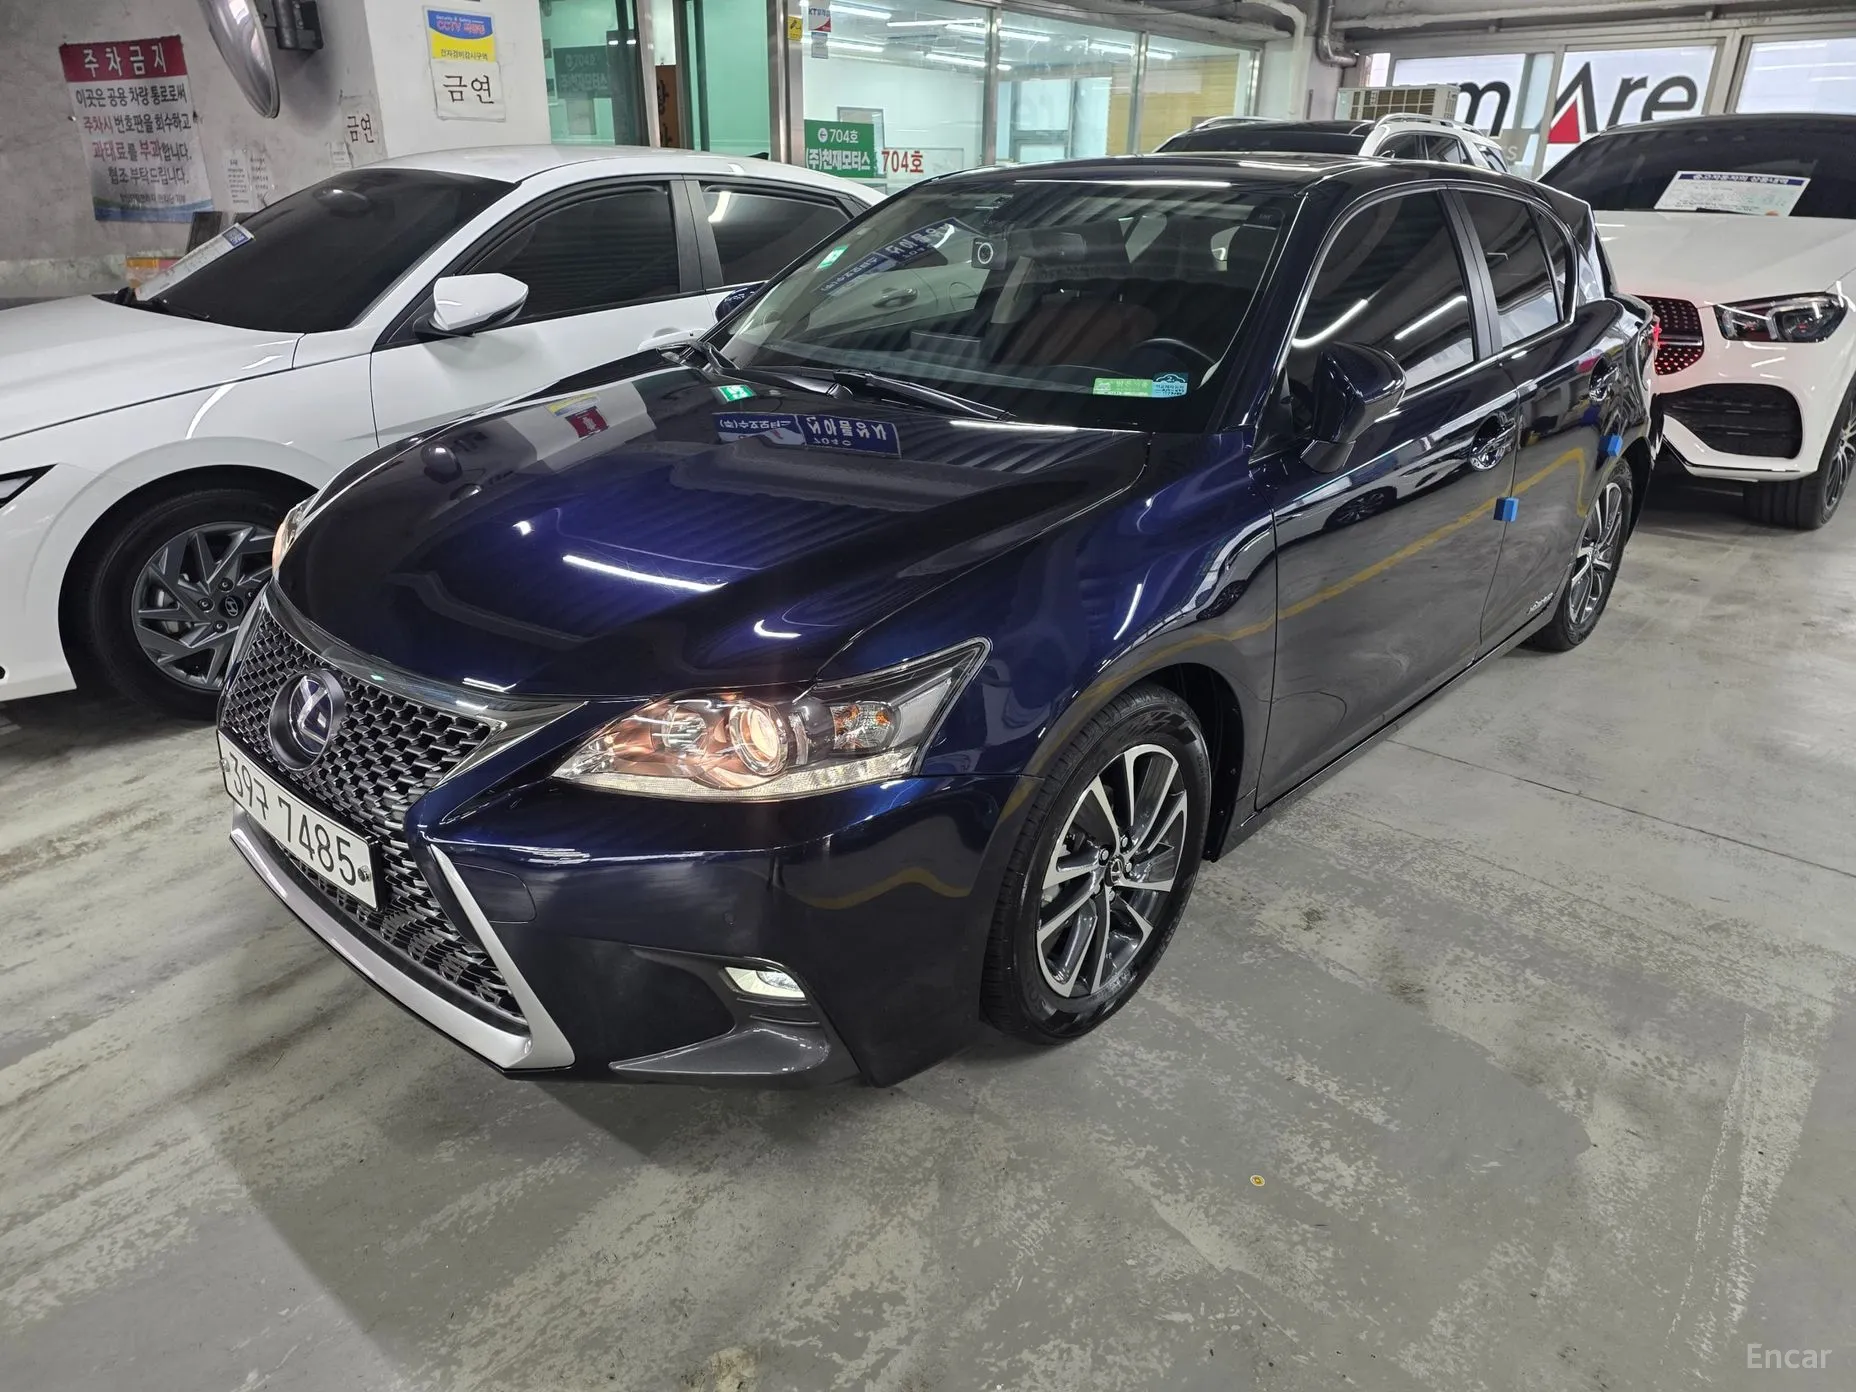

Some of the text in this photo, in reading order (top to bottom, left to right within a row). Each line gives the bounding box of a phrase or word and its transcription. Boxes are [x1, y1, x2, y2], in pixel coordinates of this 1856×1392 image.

[83, 43, 167, 78] 주차금지
[75, 83, 188, 108] 이곳은 공용 차량 통로로써
[443, 74, 494, 104] 금연
[83, 112, 192, 135] 주차시 번호판을 회수하고
[346, 113, 375, 144] 금연
[829, 128, 859, 143] 704호
[92, 140, 138, 162] 과태료를
[881, 150, 924, 173] 704호
[108, 166, 190, 185] 협조 부탁드립니다.
[229, 752, 357, 887] 39구 7485
